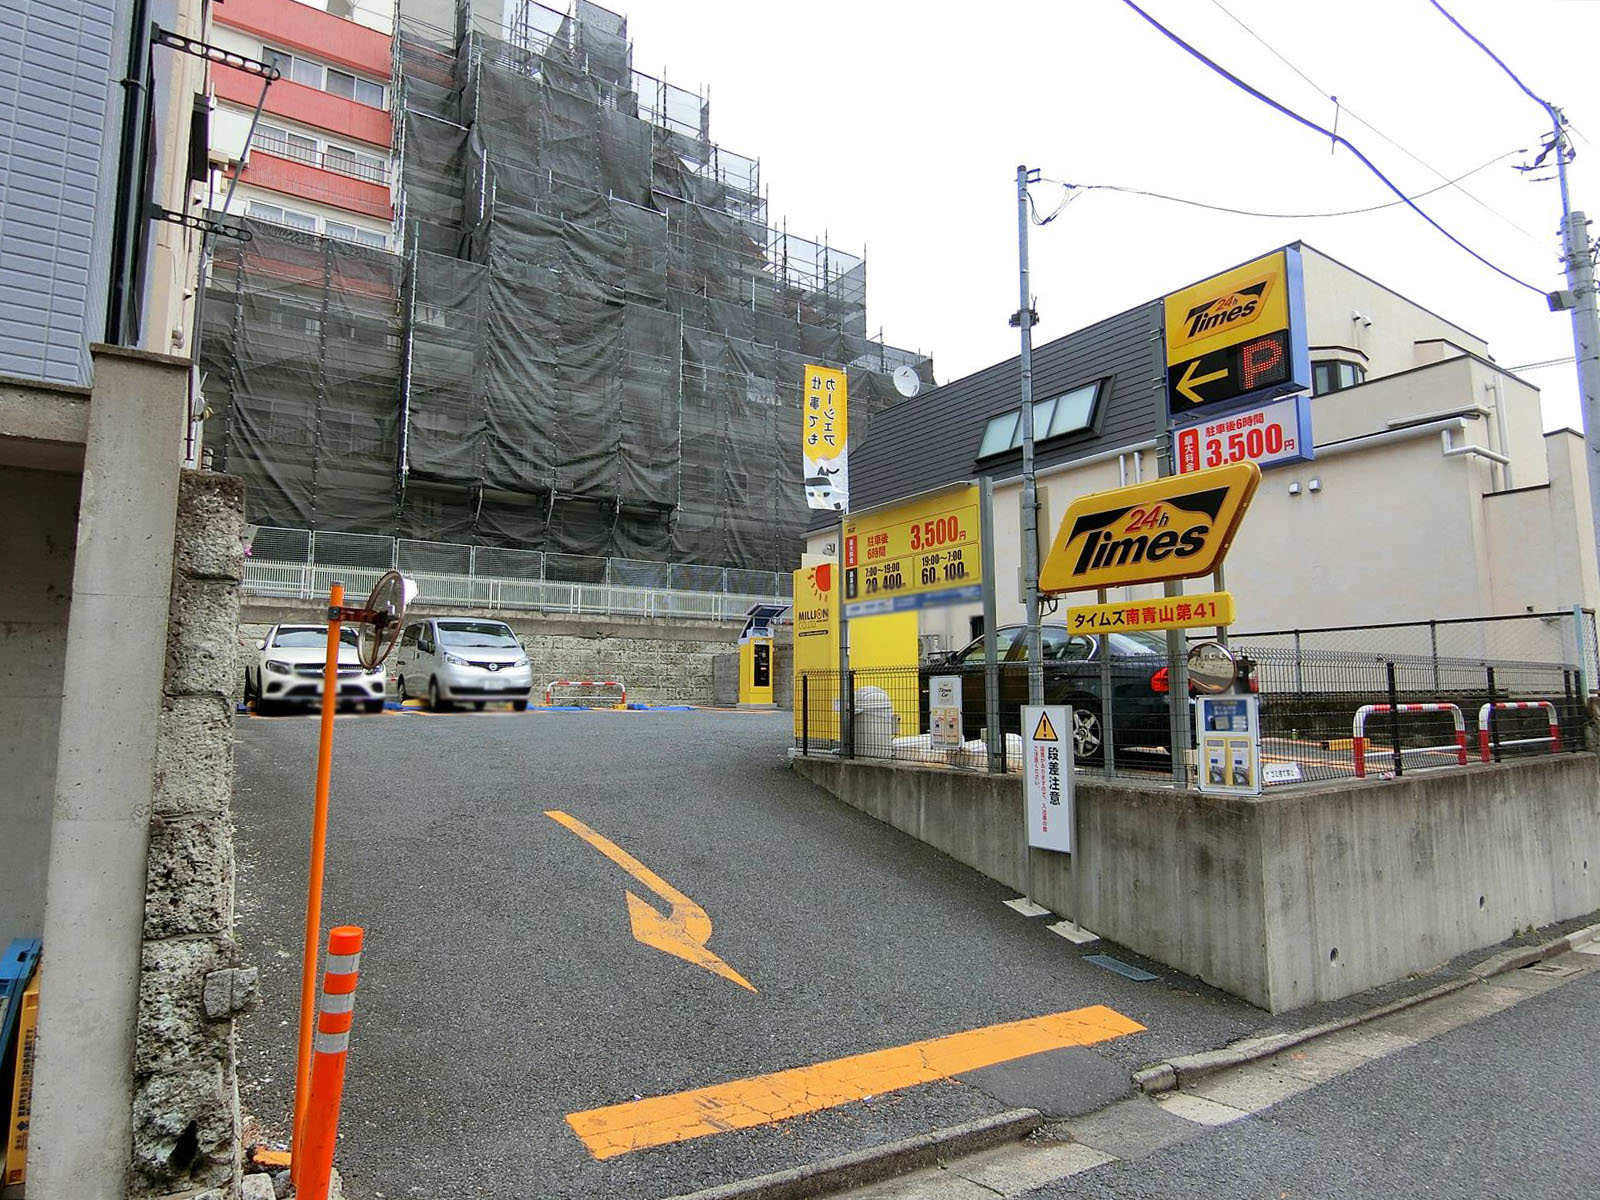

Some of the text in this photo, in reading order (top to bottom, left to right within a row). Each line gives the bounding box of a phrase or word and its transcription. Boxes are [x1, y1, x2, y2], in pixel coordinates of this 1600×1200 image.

[1186, 300, 1258, 339] Times
[1205, 412, 1265, 438] 駐車後6時間
[1124, 505, 1169, 534] 24h
[1072, 524, 1210, 577] Times
[1074, 601, 1217, 629] タイムズ南青山第41
[1047, 746, 1061, 806] 段差注意
